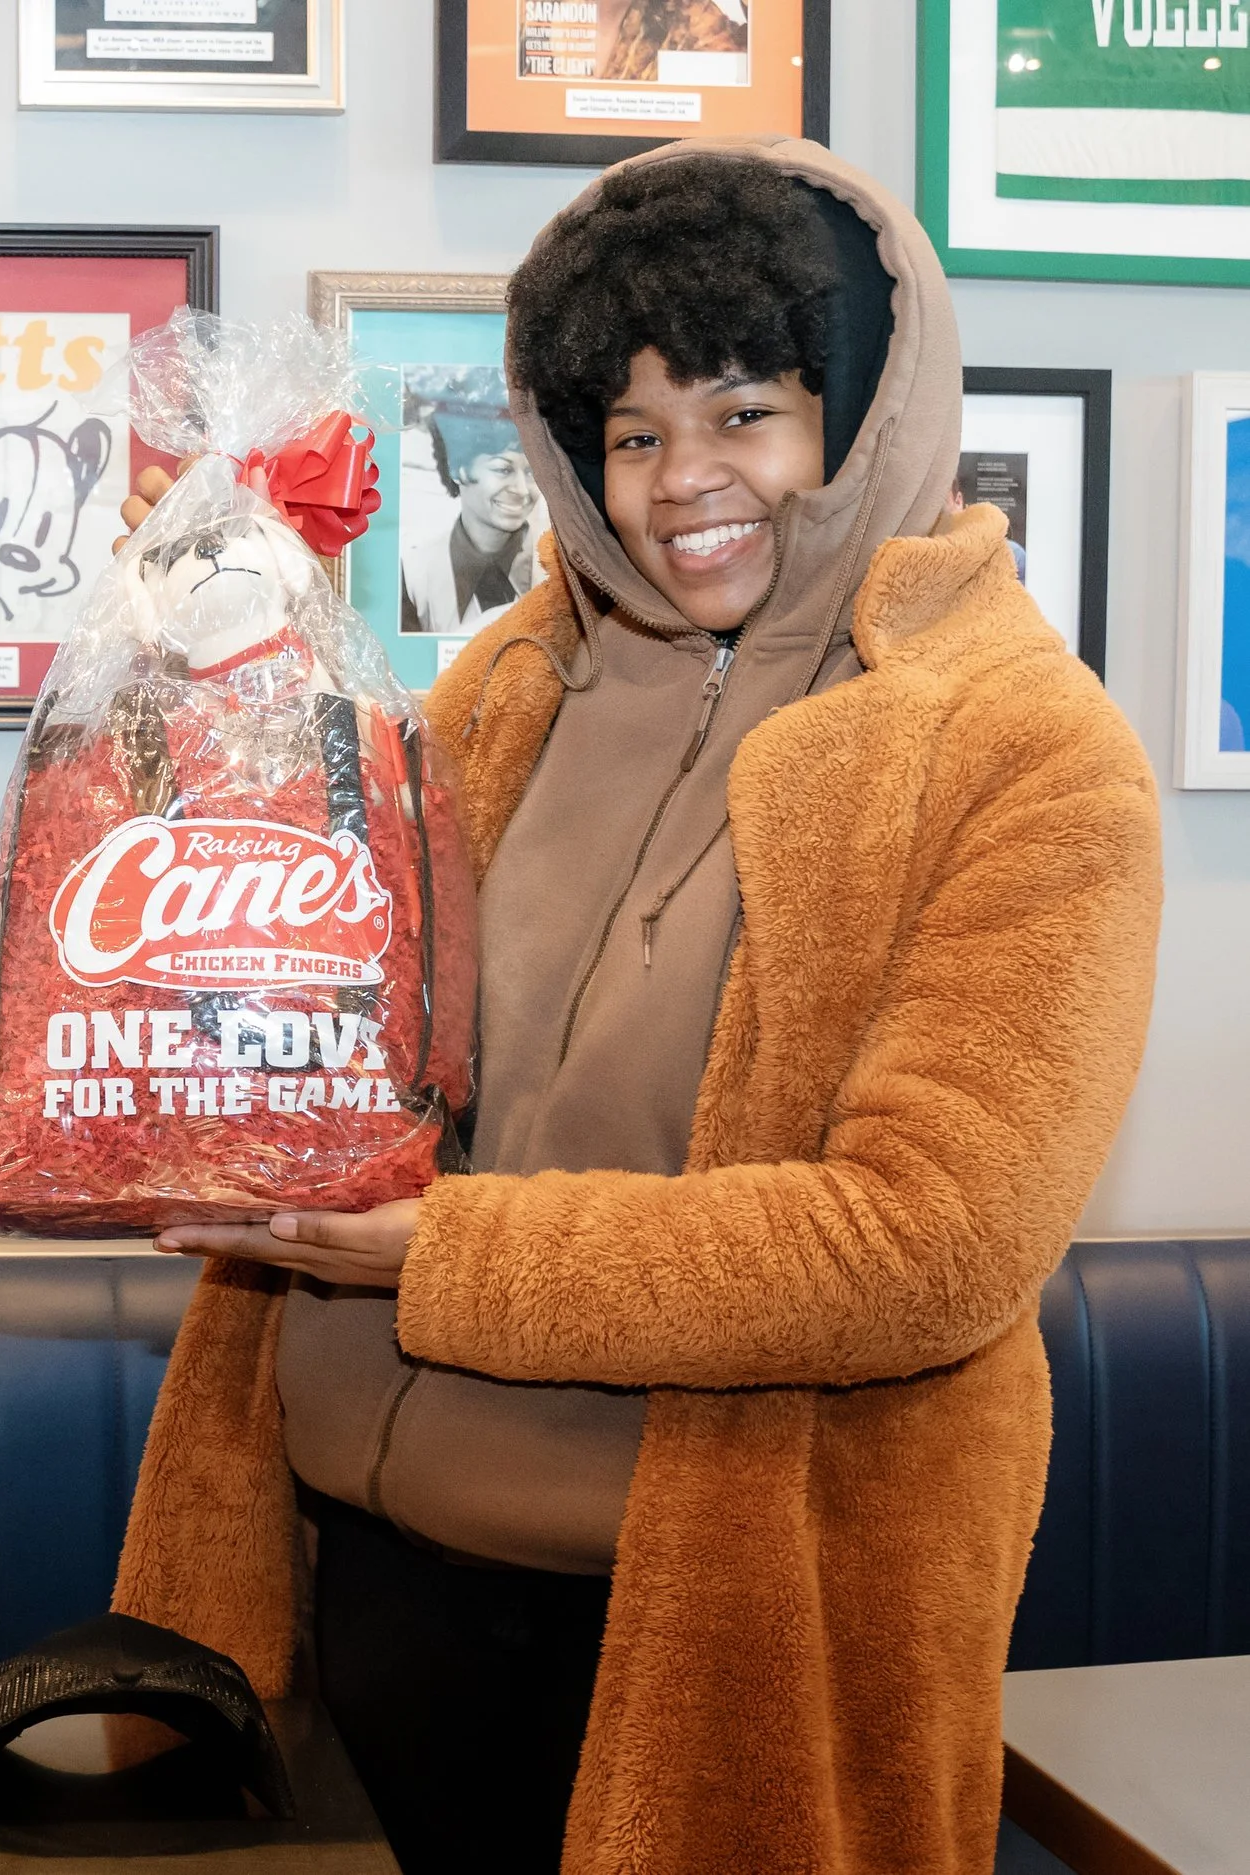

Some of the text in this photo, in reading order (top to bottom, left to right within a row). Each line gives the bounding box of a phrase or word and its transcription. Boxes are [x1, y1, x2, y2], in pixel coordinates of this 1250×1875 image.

[525, 1, 597, 23] SARANDON
[183, 832, 303, 866] Raising
[63, 824, 387, 973] Cane's
[170, 953, 362, 979] CHICKEN FINGERS
[47, 1009, 192, 1070] ONE
[43, 1077, 401, 1118] FOR THE GAME
